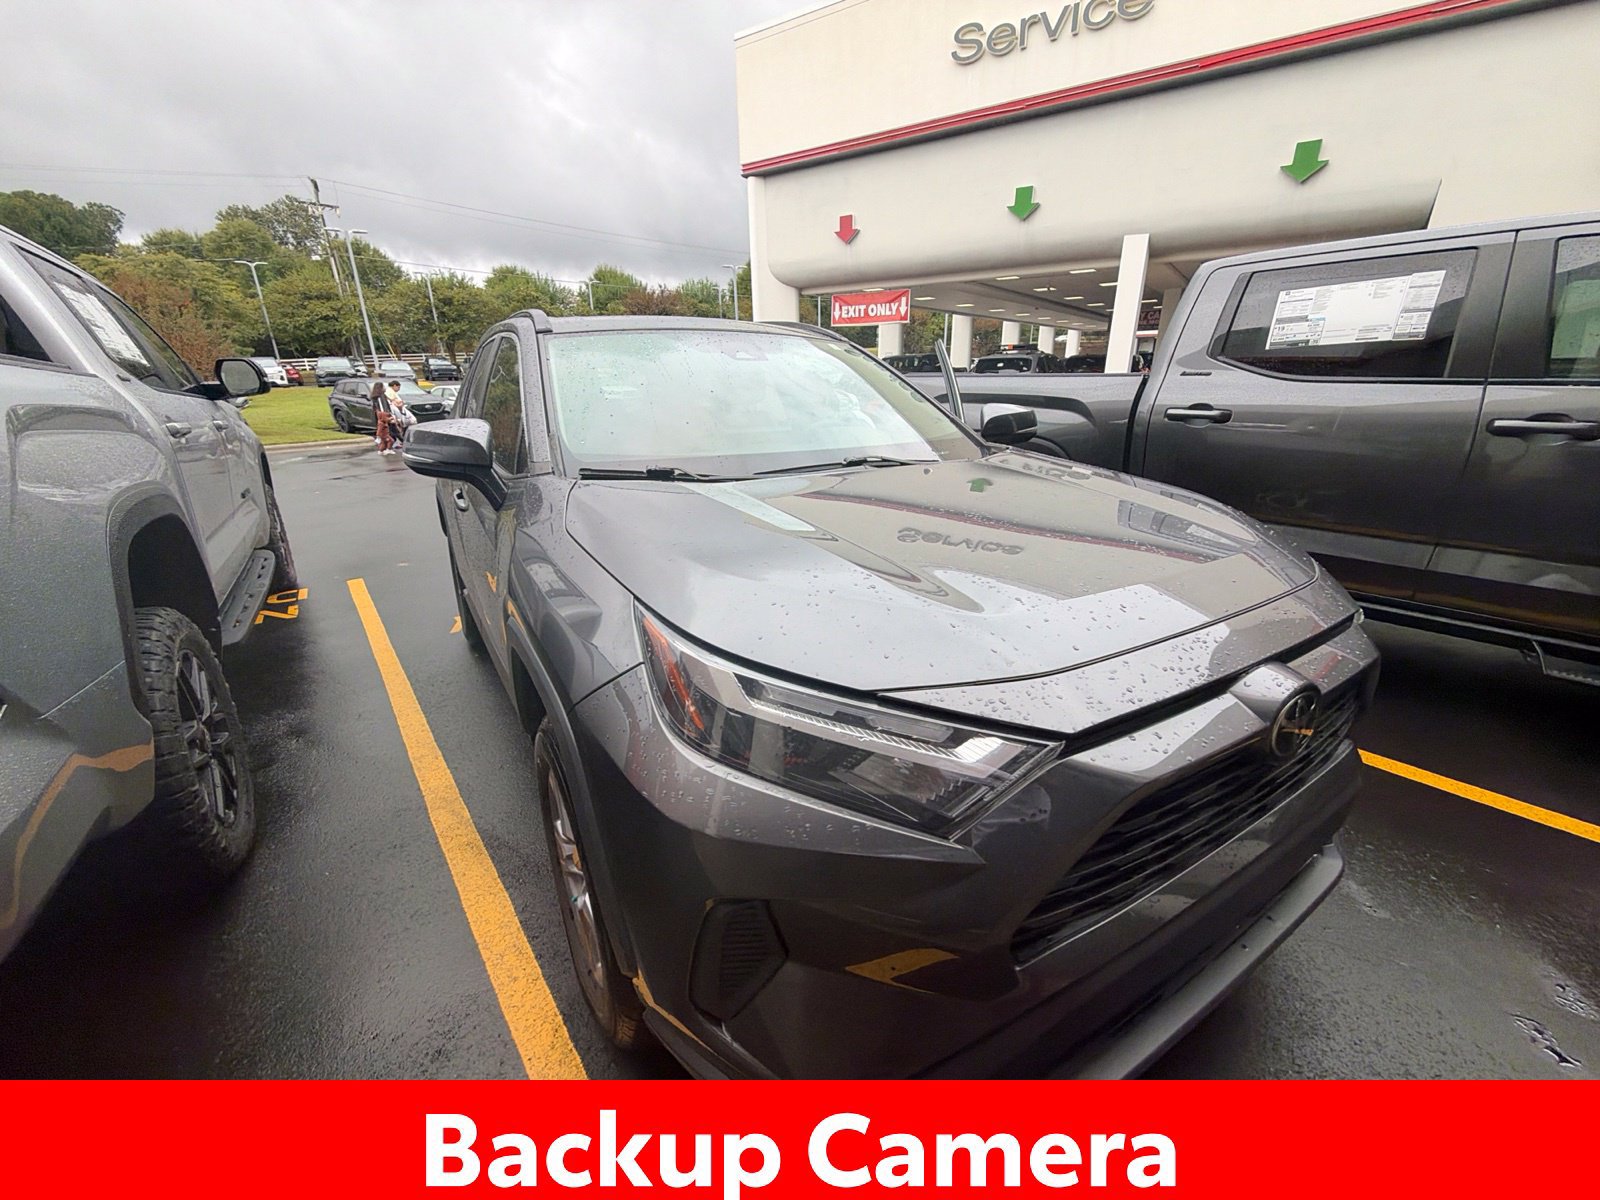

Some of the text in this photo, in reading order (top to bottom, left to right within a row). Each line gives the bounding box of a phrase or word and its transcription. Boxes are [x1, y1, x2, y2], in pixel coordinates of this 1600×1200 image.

[950, 0, 1155, 65] Service
[841, 302, 899, 319] EXIT ONLY
